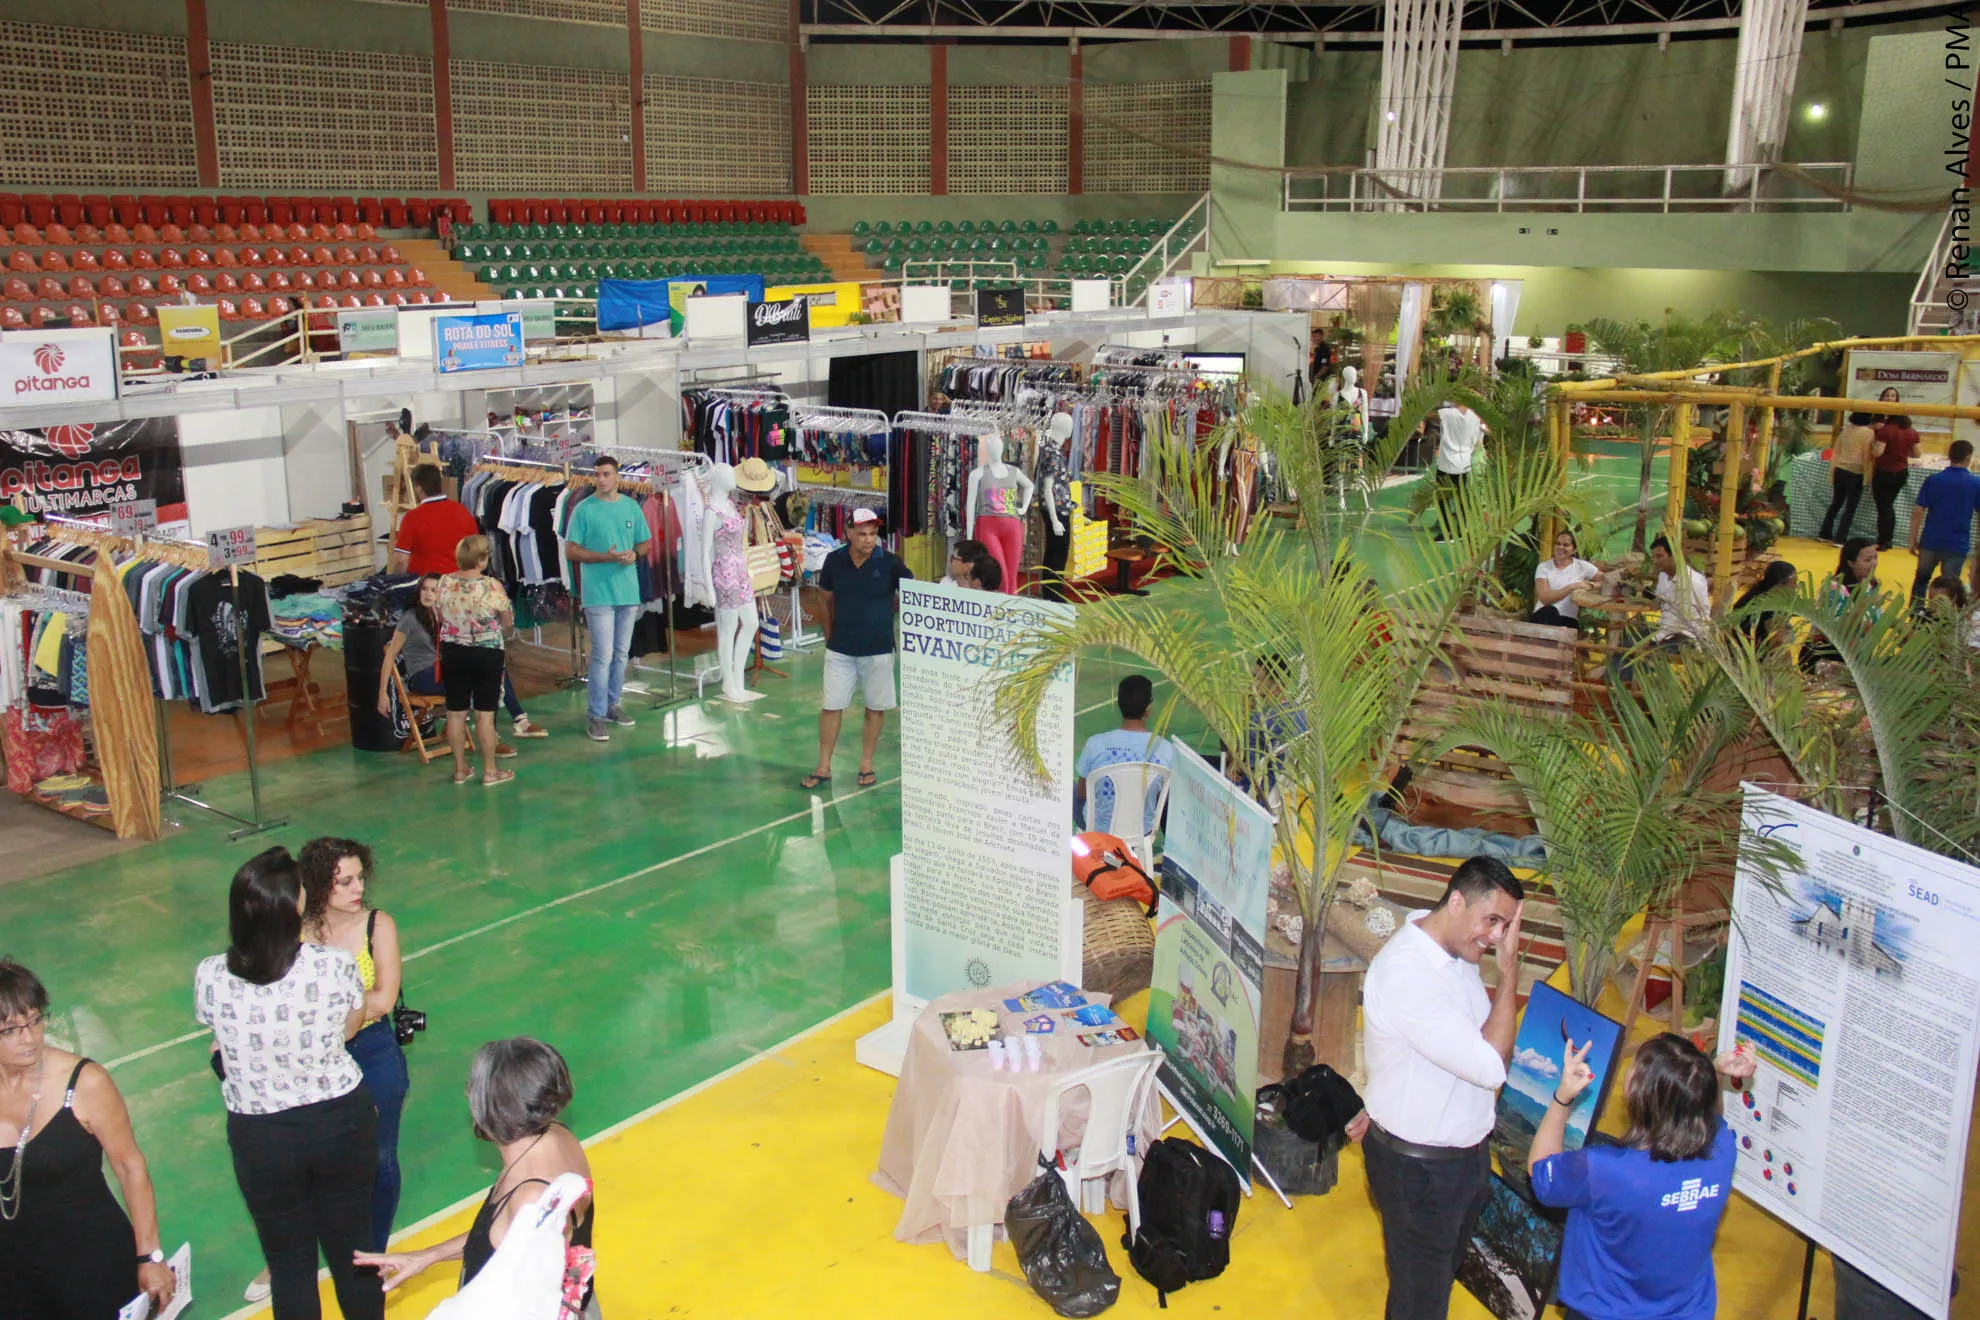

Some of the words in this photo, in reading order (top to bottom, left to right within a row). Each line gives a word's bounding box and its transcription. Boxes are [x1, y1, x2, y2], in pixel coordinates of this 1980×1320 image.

[444, 326, 474, 341] ROTA
[494, 323, 515, 337] SOL
[480, 339, 508, 349] FITNESS
[14, 375, 90, 394] pitanga
[0, 454, 141, 498] pitanga
[117, 505, 133, 519] 69
[211, 534, 219, 548] 4
[224, 548, 231, 559] 3
[902, 590, 1017, 624] ENFERMIDADE
[1022, 611, 1047, 629] OU
[1907, 884, 1939, 906] SEAD
[1213, 1105, 1244, 1153] 3269-1171
[1660, 1183, 1720, 1207] SEBRAE
